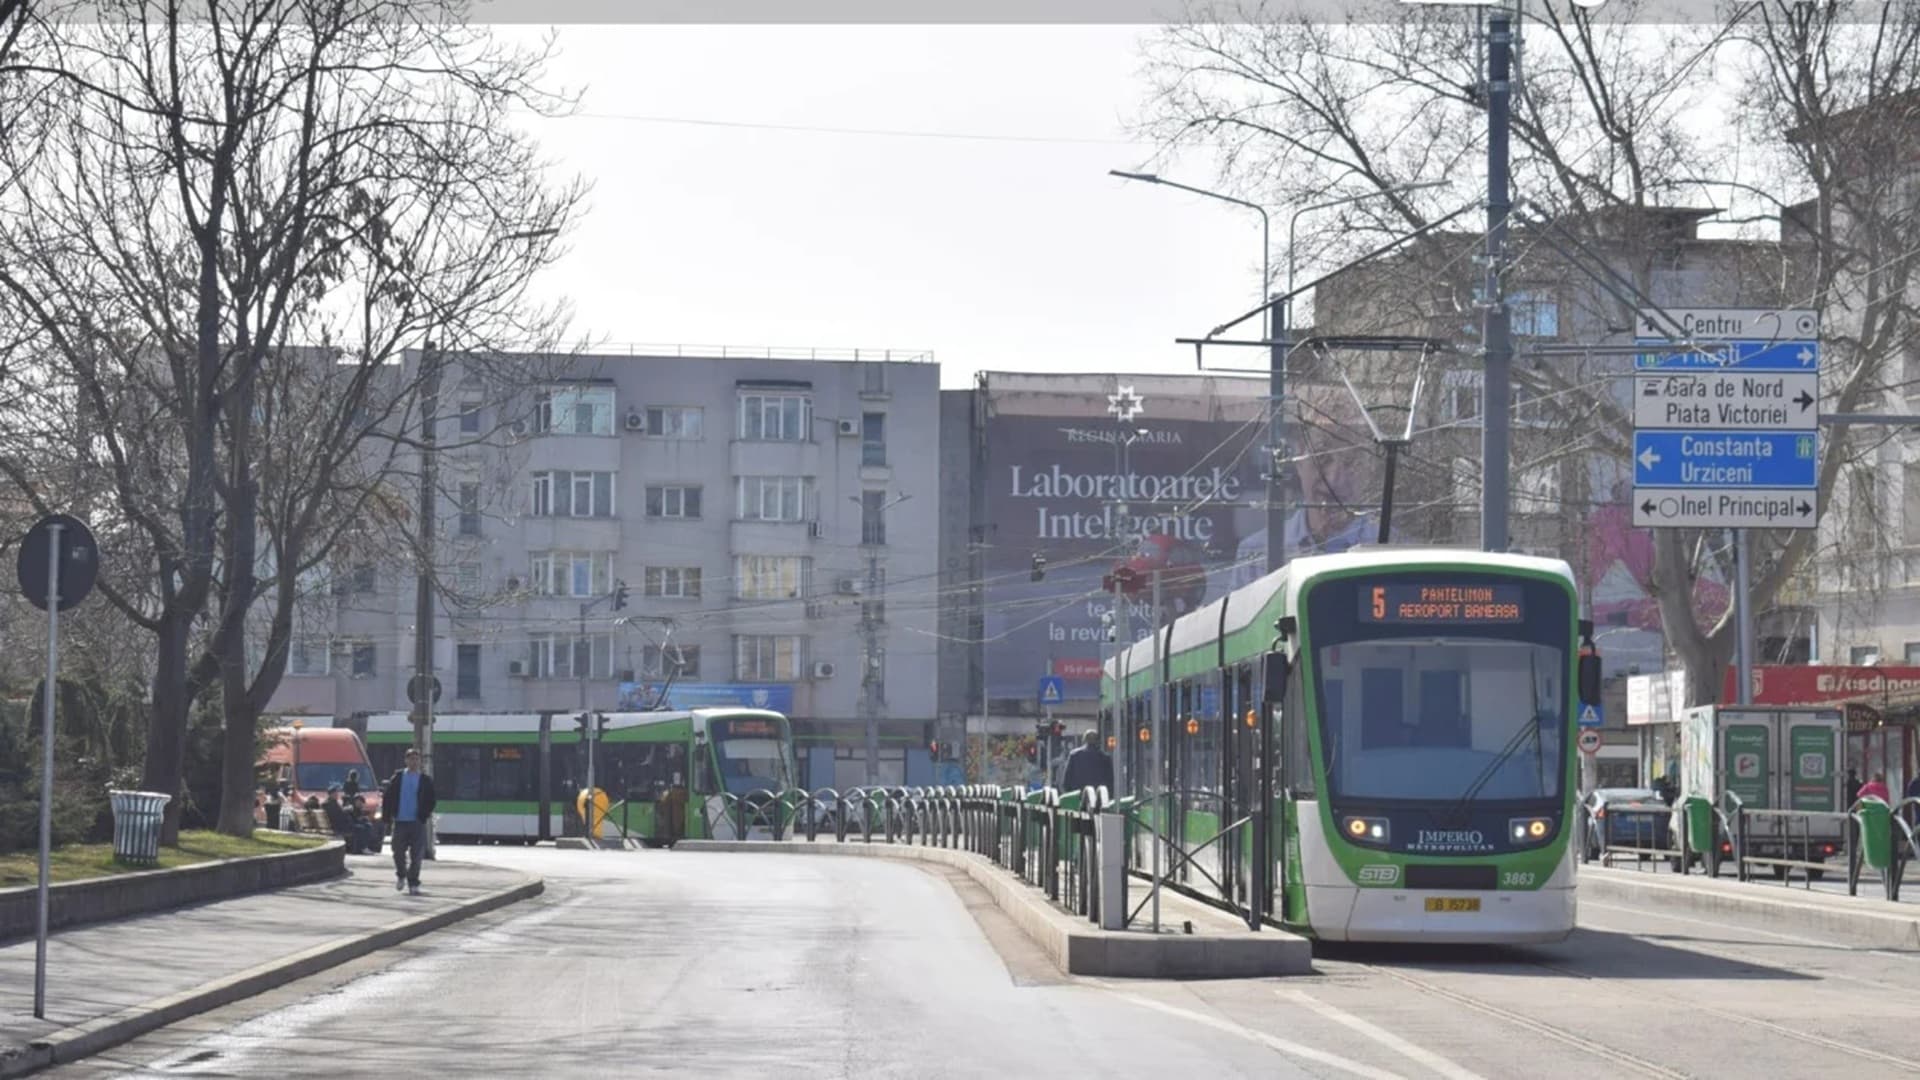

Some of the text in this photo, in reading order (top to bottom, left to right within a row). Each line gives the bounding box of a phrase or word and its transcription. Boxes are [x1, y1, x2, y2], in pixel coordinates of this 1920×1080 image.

[1684, 313, 1742, 334] Centru
[1667, 377, 1784, 398] Gara de Nord
[1718, 403, 1788, 424] Victoriei
[1681, 436, 1773, 460] Constanța
[1009, 464, 1240, 500] Laboratoarele
[1681, 462, 1753, 483] Urziceni
[1681, 495, 1794, 520] Inel Principal
[1372, 587, 1386, 619] 5
[1421, 588, 1493, 602] PANTELIMON
[1399, 604, 1460, 618] AEROPORT
[1050, 623, 1065, 641] la
[1407, 843, 1494, 851] METROPOLITAN
[1418, 830, 1483, 845] IMPERIO
[1503, 872, 1535, 885] 3863
